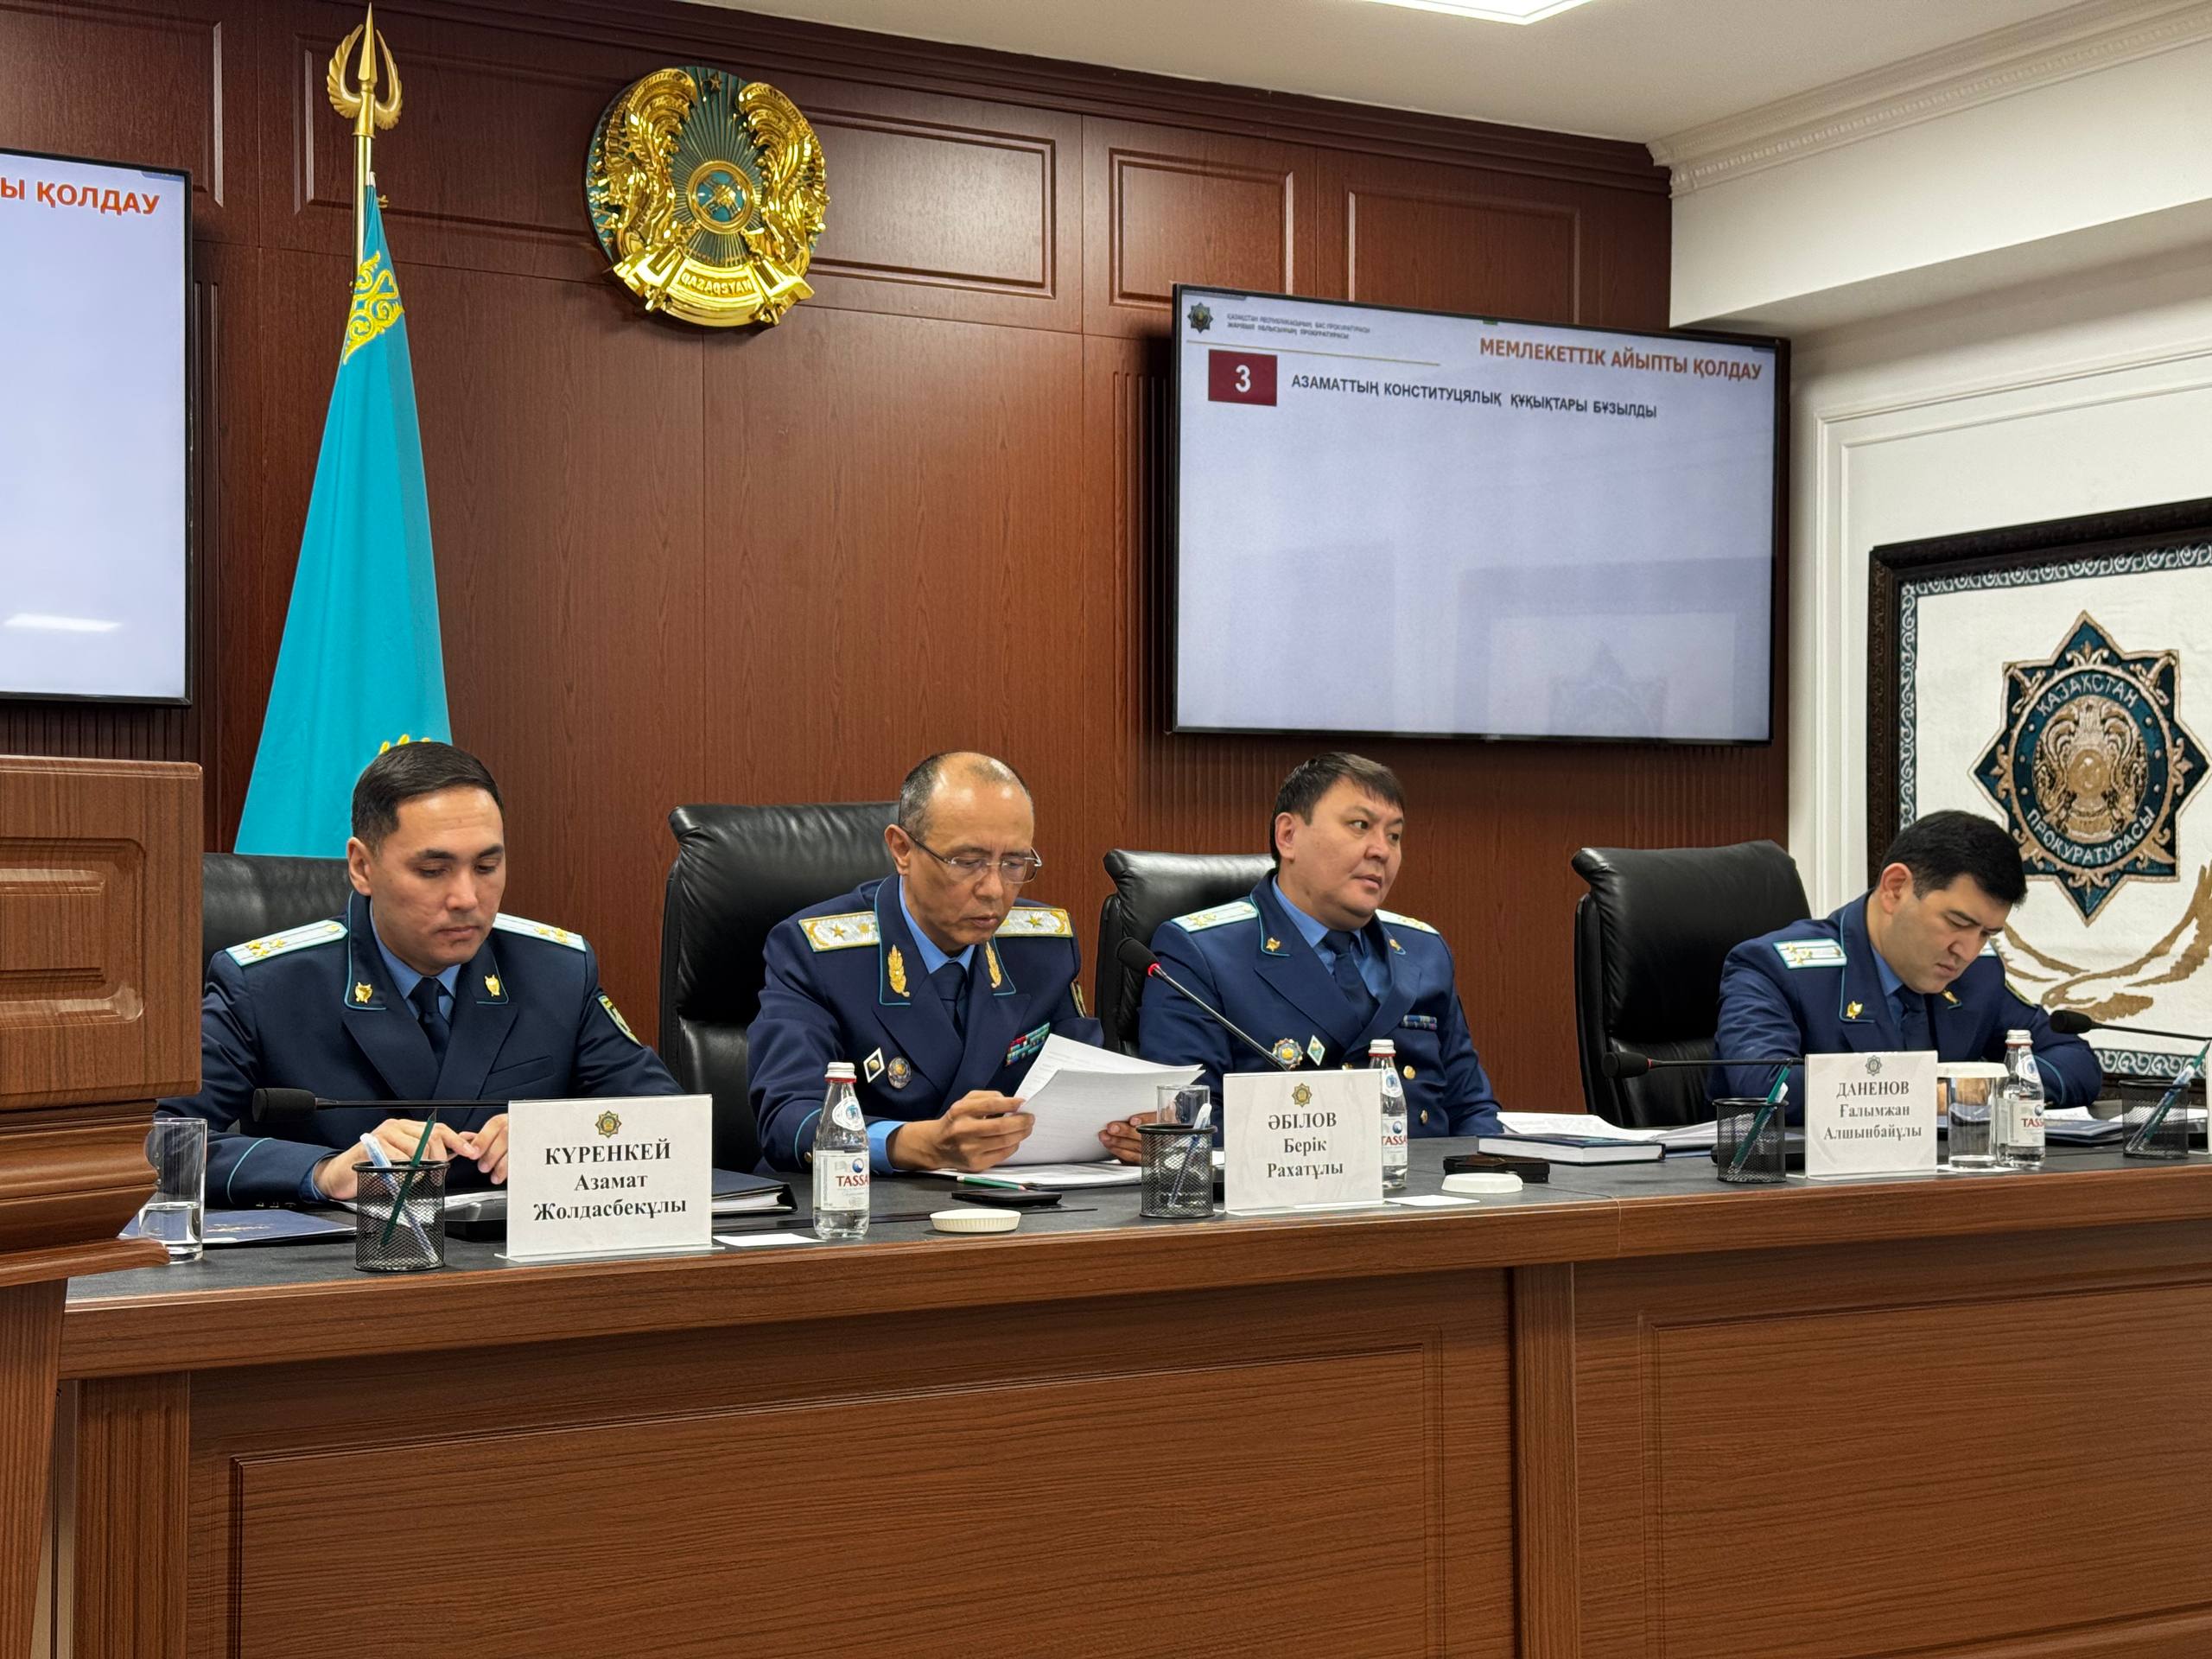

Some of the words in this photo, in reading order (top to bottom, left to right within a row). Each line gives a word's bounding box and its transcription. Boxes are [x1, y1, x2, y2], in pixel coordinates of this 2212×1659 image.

[37, 181, 160, 216] ҚОЛДАУ
[681, 272, 753, 295] QAZAQSTAN
[1480, 337, 1605, 365] МЕМЛЕКЕТТІК
[1611, 347, 1688, 373] АЙЫПТЫ
[1694, 359, 1762, 381] ҚОЛДАУ
[1235, 364, 1251, 392] 3
[1292, 375, 1379, 397] АЗАМАТТЫҢ
[1510, 393, 1587, 412] ҚҰҚЫҚТАРЫ
[1593, 401, 1656, 418] БҰЗЫЛДЫ
[2027, 805, 2156, 864] ПРОКУРАТУРАСЫ
[1836, 1081, 1910, 1099] ДАНЕНОВ
[1268, 1112, 1337, 1130] ӘБІЛОВ
[1840, 1103, 1910, 1117] Ғалымжан
[1824, 1124, 1922, 1141] Алшынбайұлы
[545, 1138, 671, 1166] КҮРЕНКЕЙ
[1284, 1136, 1327, 1156] Берік
[574, 1174, 648, 1191] Азамат
[1268, 1163, 1343, 1179] Рахатұлы
[533, 1198, 686, 1221] Жолдасбекұлы
